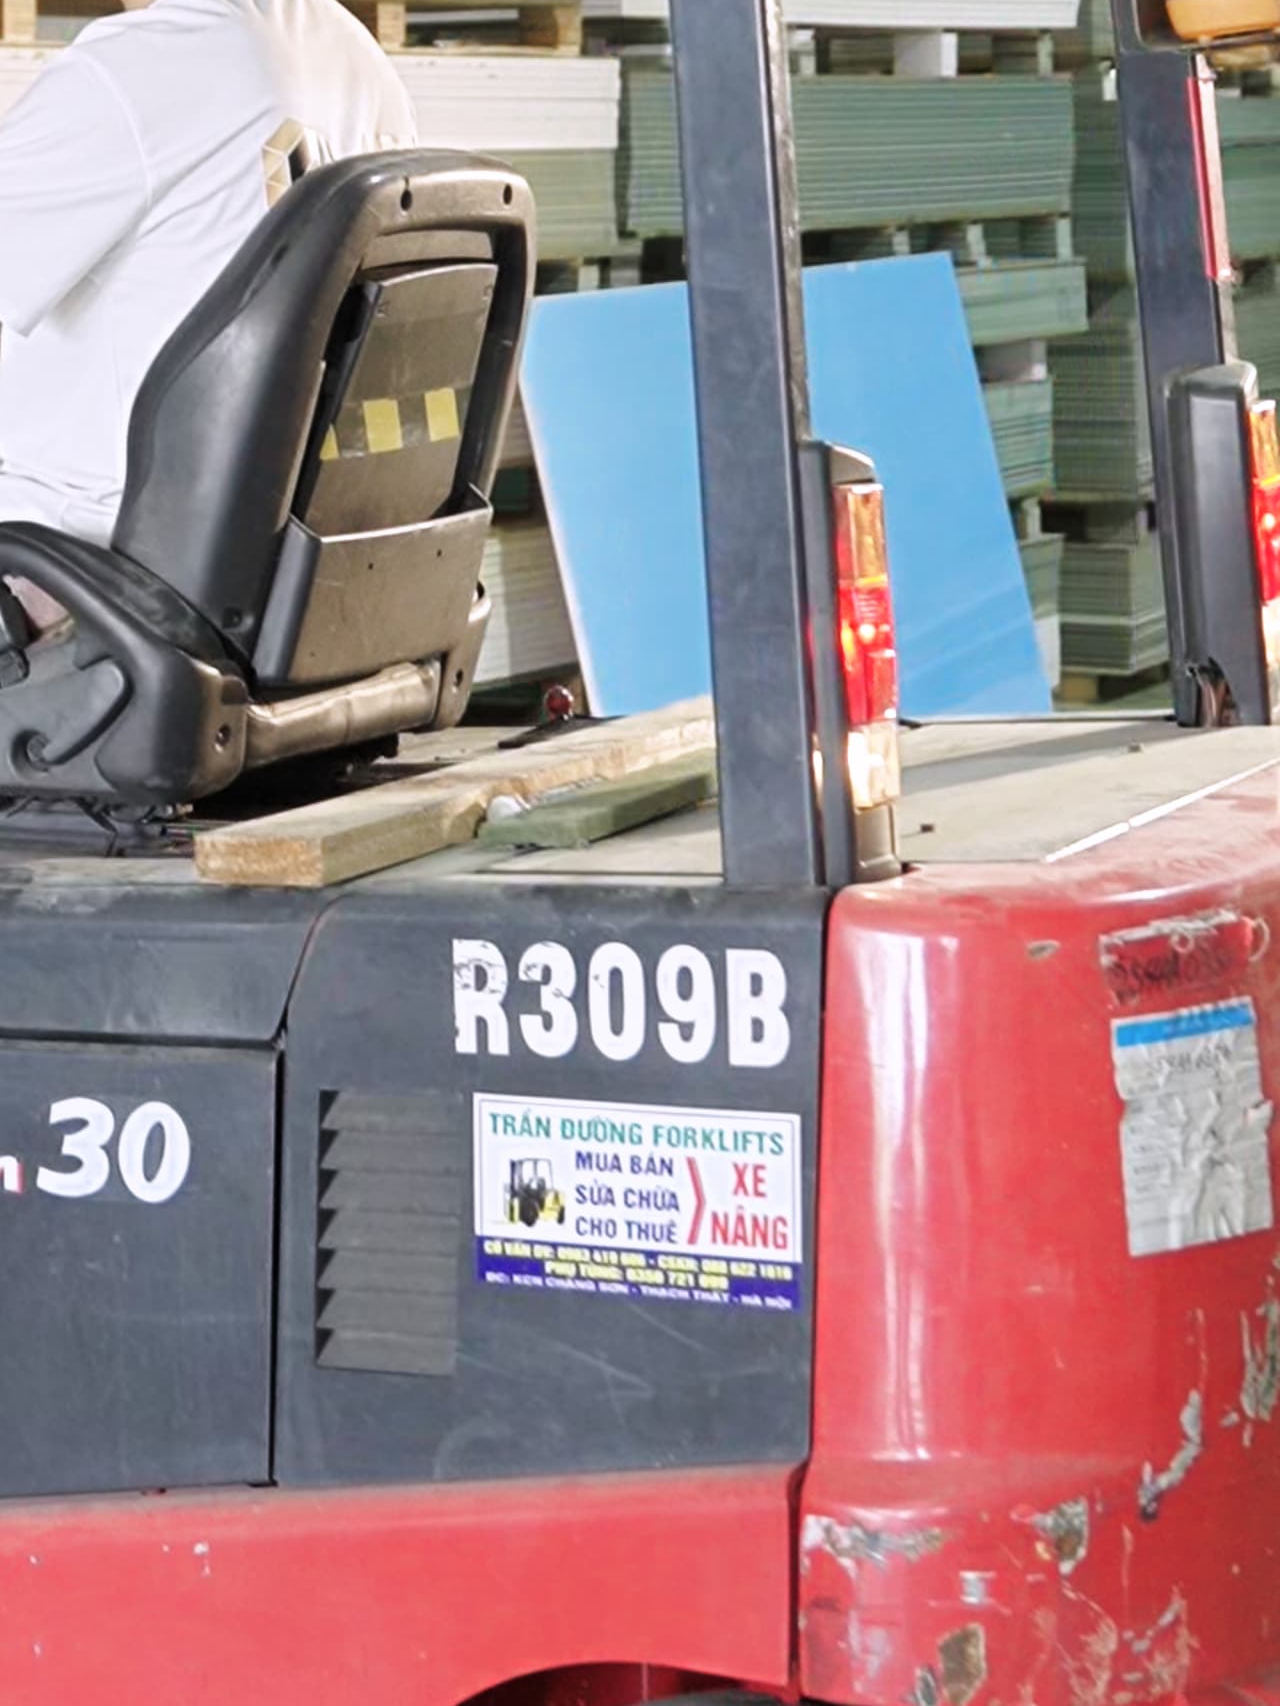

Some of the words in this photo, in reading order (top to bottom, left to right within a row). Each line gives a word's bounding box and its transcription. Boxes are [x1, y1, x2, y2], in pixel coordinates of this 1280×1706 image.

[452, 938, 790, 1068] R309B
[36, 1097, 191, 1203] 30
[653, 1124, 784, 1156] FORKLIFTS
[575, 1150, 623, 1174] MUA
[733, 1162, 767, 1198] XE
[575, 1216, 617, 1240] CHO
[711, 1205, 788, 1251] NÂNG
